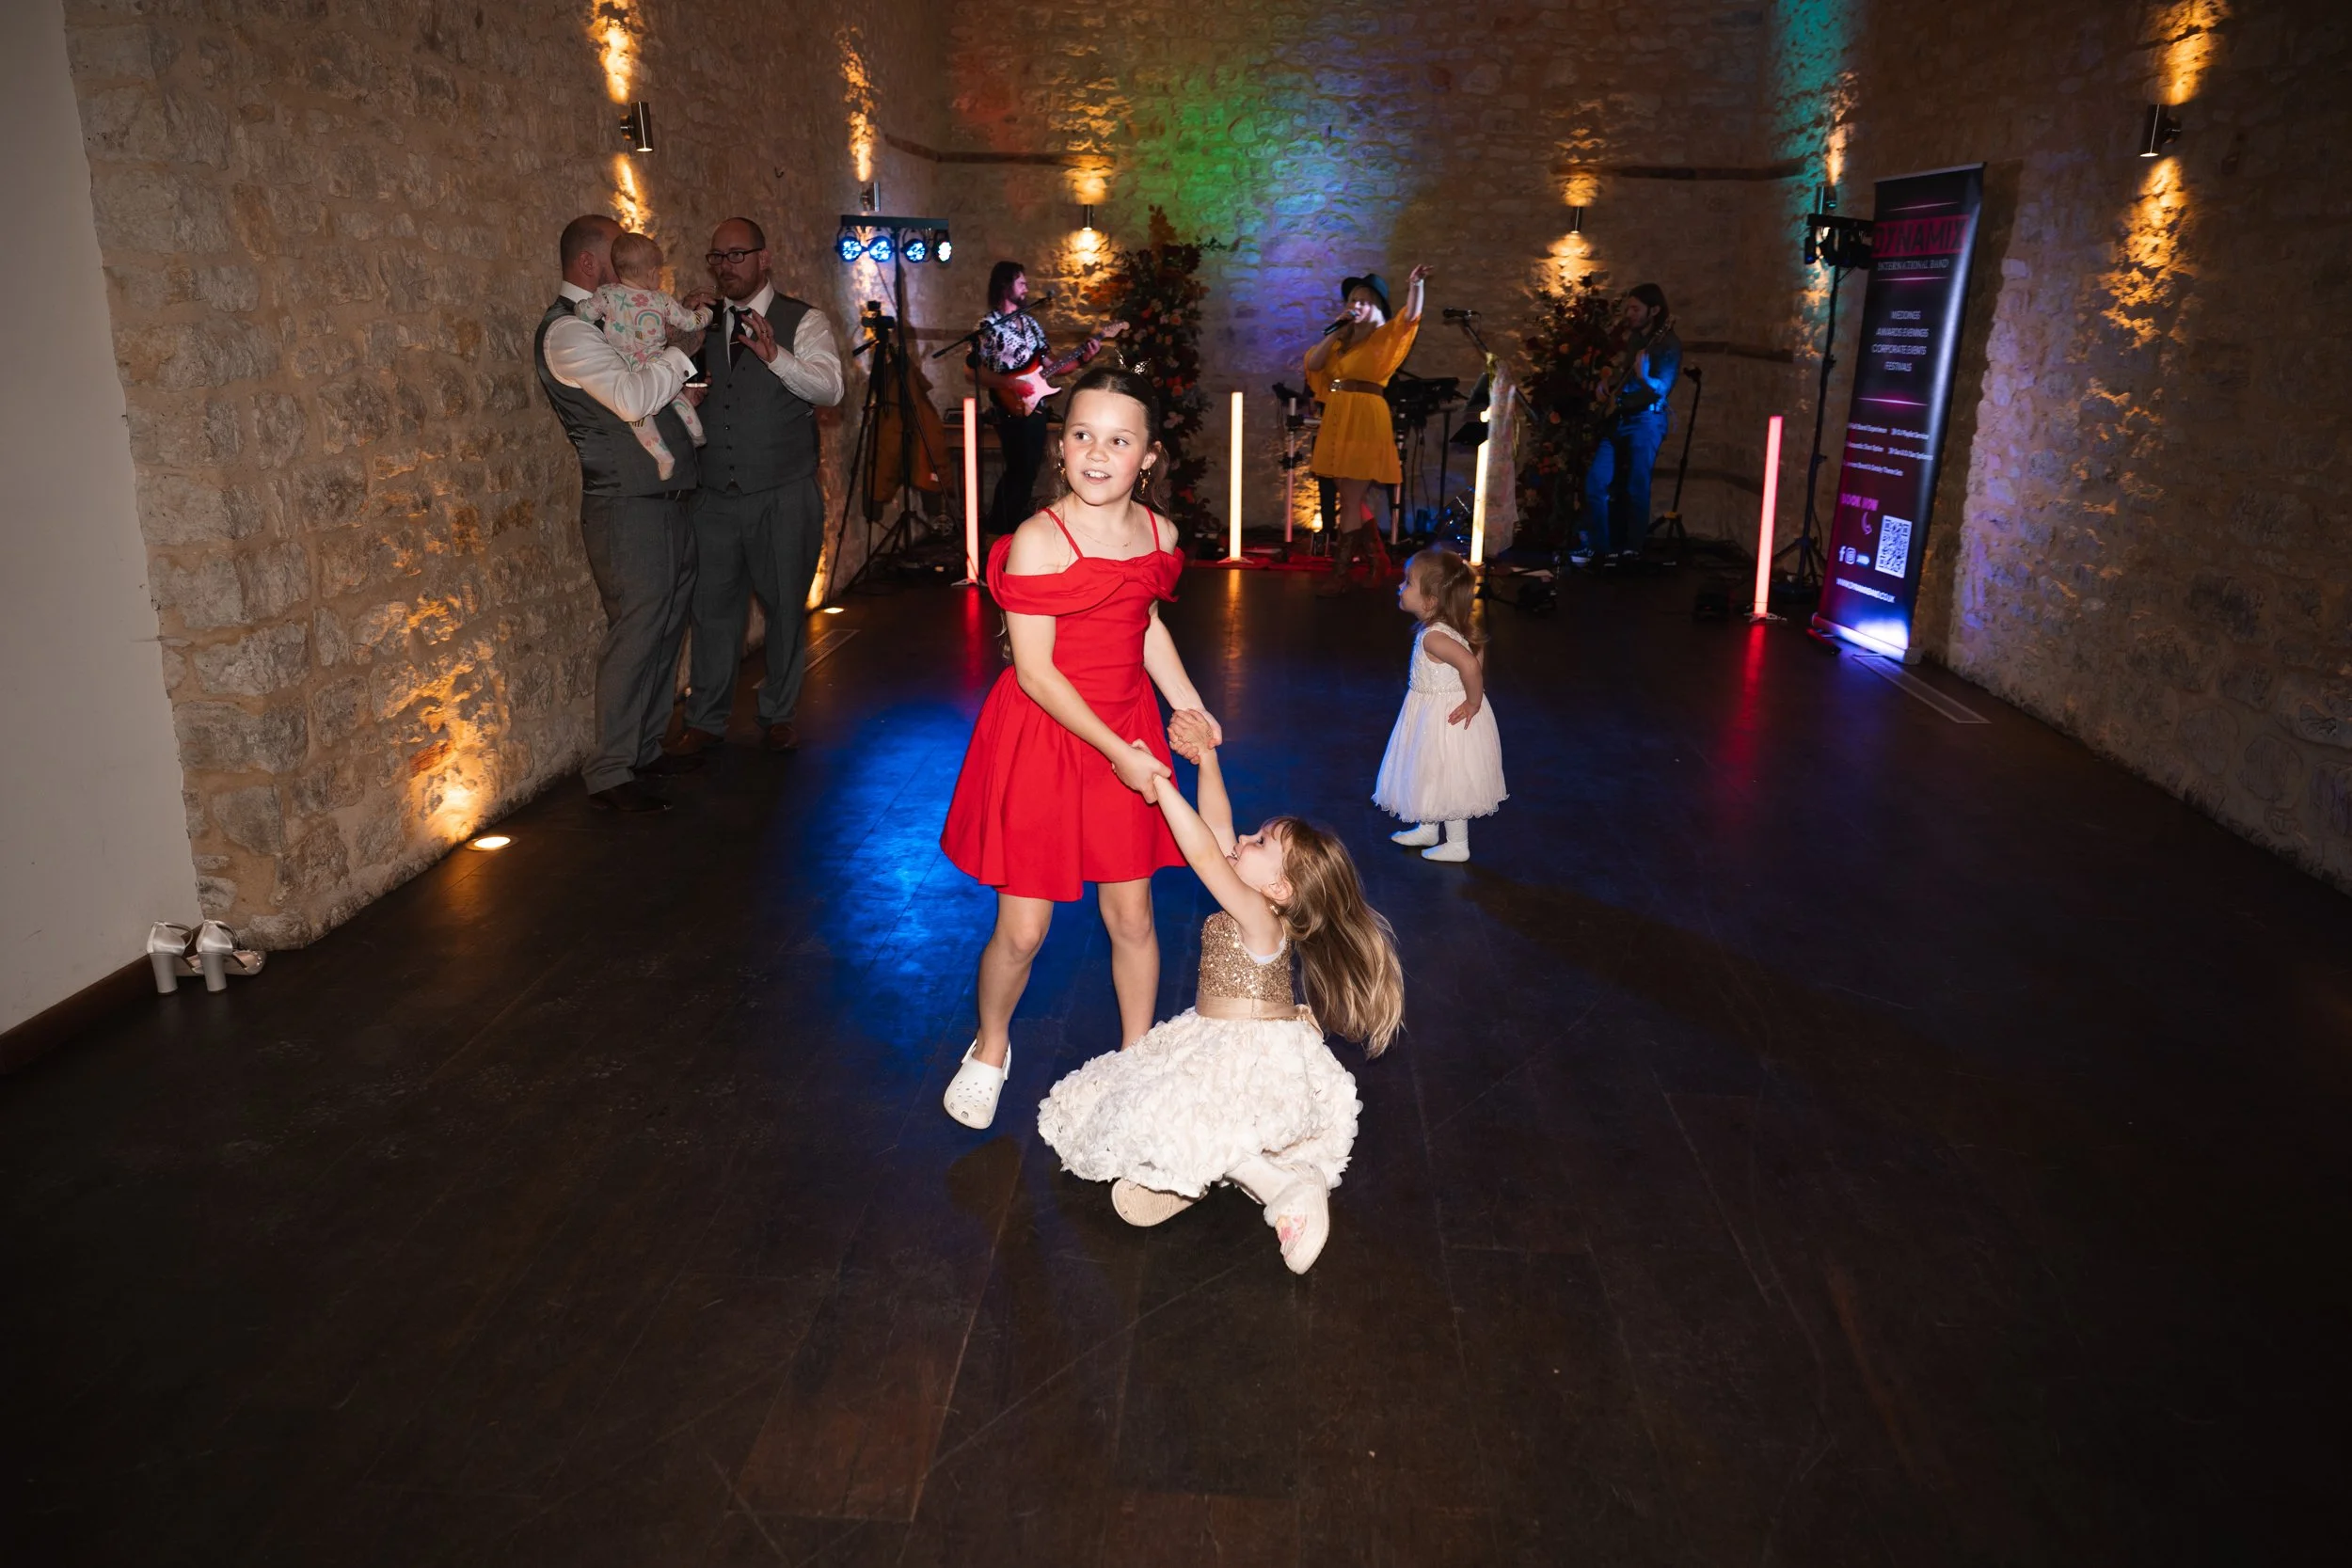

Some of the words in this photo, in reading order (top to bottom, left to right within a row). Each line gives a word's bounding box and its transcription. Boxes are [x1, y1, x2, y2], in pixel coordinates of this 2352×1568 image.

[1873, 219, 1966, 254] DYNAMIX
[1877, 261, 1929, 271] INTERNATIONAL
[1930, 259, 1949, 269] BAND
[1871, 344, 1906, 355] CORPORATE
